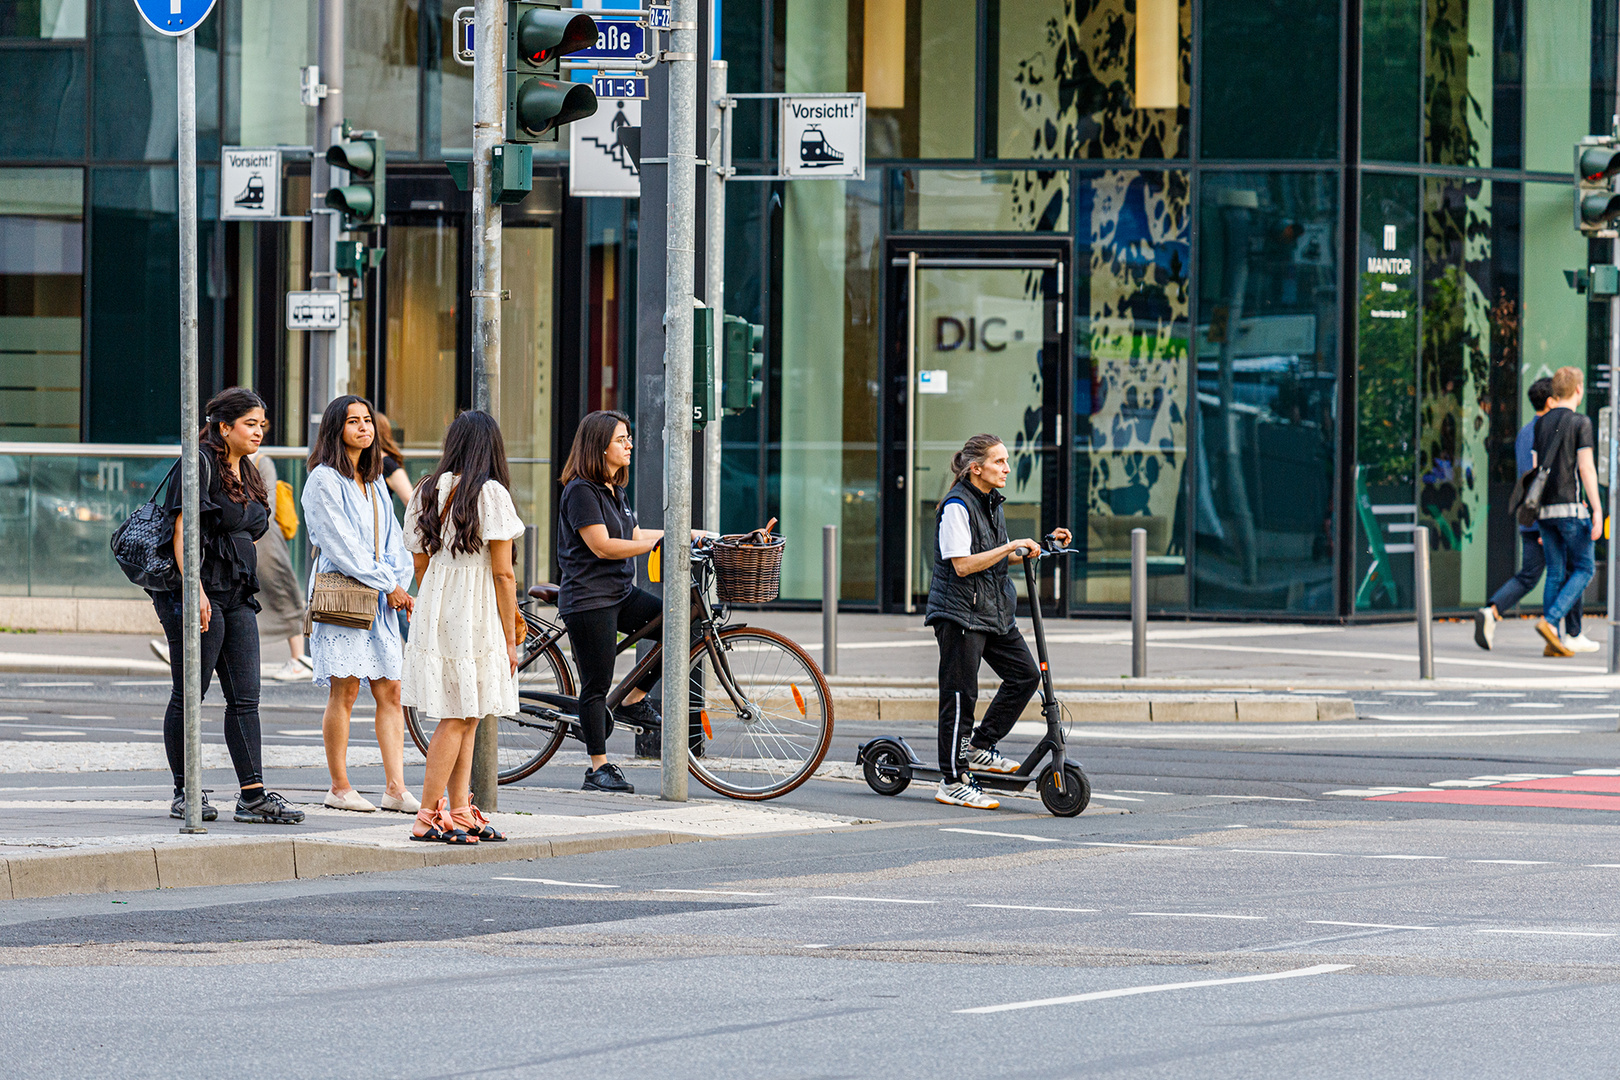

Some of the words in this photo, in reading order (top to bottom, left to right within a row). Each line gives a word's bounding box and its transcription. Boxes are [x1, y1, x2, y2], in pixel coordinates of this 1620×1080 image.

[651, 9, 670, 27] 26-22
[595, 25, 631, 50] aße
[597, 79, 635, 97] 11-3
[791, 103, 855, 119] Vorsicht!
[229, 154, 272, 168] Vorsicht!
[1367, 257, 1411, 275] MAINTOR
